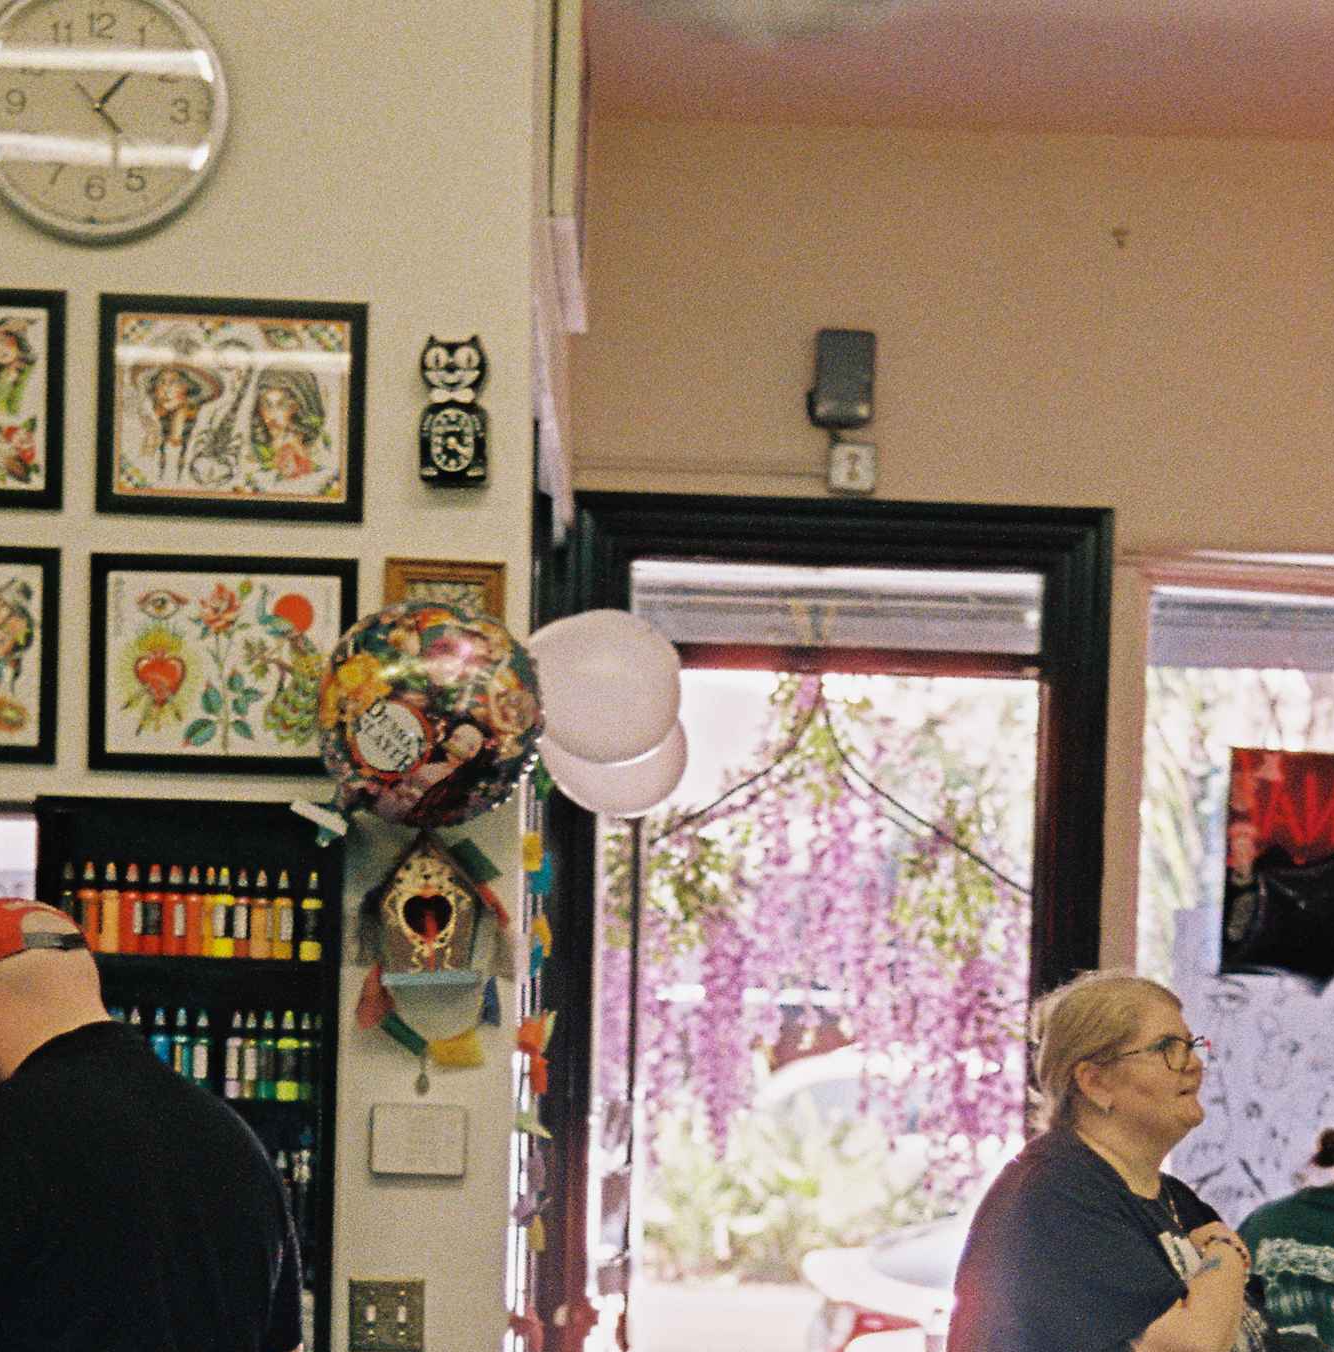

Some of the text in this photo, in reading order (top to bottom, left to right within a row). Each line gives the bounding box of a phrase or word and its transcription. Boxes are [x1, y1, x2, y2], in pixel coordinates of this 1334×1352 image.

[89, 12, 117, 40] 12
[5, 88, 28, 115] 9
[168, 98, 192, 125] 3
[83, 174, 107, 201] 6
[124, 167, 147, 193] 5
